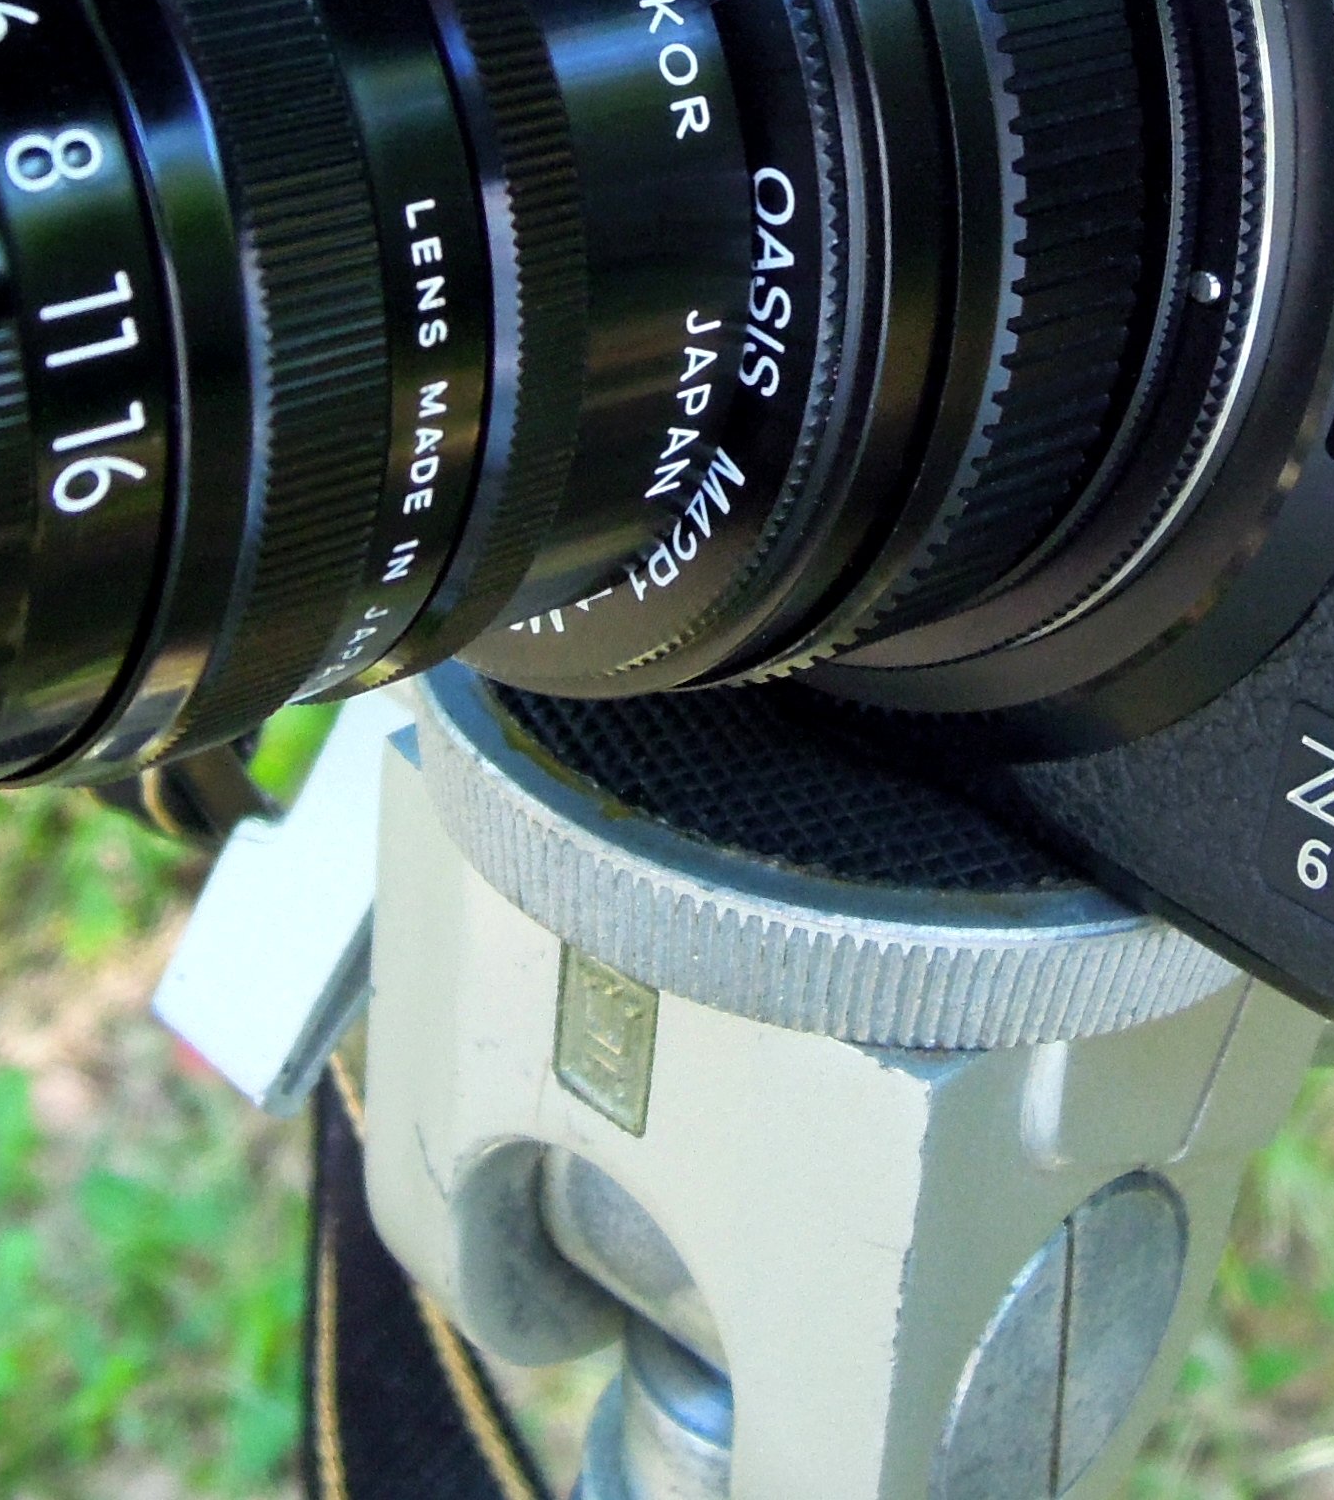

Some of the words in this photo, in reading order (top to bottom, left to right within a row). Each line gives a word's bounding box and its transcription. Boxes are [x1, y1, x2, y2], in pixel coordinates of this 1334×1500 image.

[4, 127, 104, 192] 8
[40, 269, 140, 368] 11
[404, 197, 449, 349] LENS
[739, 166, 796, 397] OASIS
[51, 401, 148, 513] 16
[401, 379, 450, 516] MADE
[644, 309, 723, 499] JAPAN
[381, 538, 420, 583] IN
[1296, 838, 1333, 891] 6
